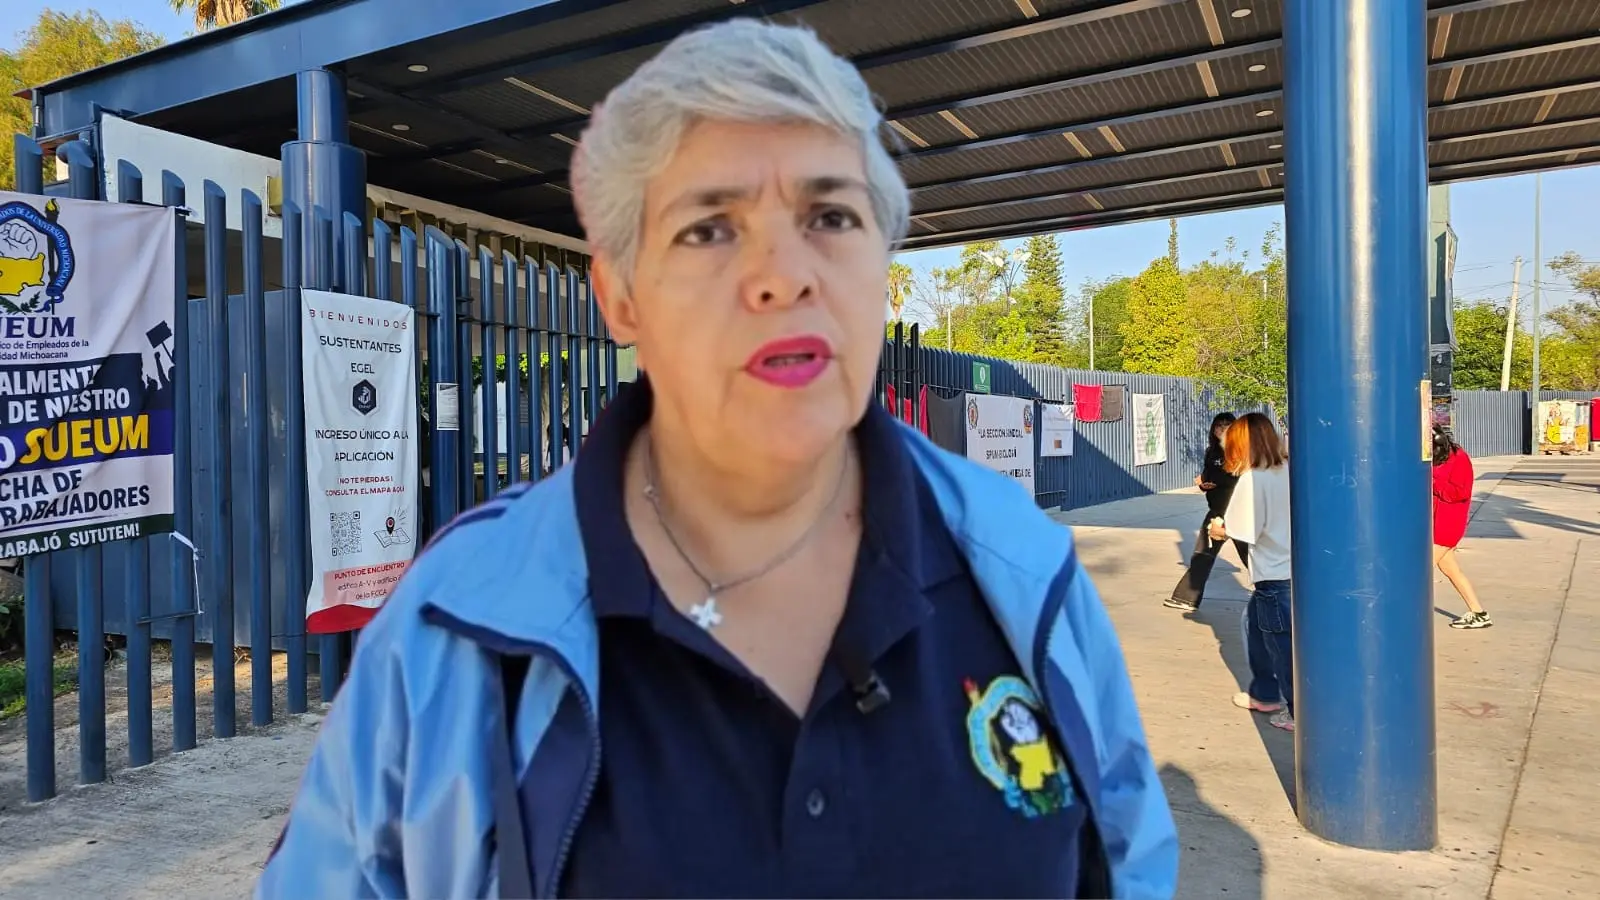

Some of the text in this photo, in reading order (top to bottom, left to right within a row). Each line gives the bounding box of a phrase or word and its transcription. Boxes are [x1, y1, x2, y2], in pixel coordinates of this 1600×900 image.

[0, 316, 76, 339] EUM
[309, 309, 408, 330] BIENVENIDOS
[13, 341, 24, 350] de
[26, 339, 70, 350] Empleados
[71, 339, 80, 348] de
[81, 339, 90, 347] la
[319, 335, 402, 354] SUSTENTANTES
[19, 350, 69, 361] Michoacana
[350, 362, 376, 374] EGEL
[8, 399, 40, 424] DE
[19, 414, 149, 465] SUEUM
[315, 429, 358, 440] INGRESO
[393, 430, 400, 440] A
[52, 468, 82, 493] DE
[350, 476, 360, 484] TE
[325, 488, 359, 497] CONSULTA
[360, 487, 370, 495] EL
[369, 486, 391, 495] MAPA
[69, 522, 140, 548] SUTUTEM!
[334, 561, 405, 580] PUNTO DE ENCUENTRO
